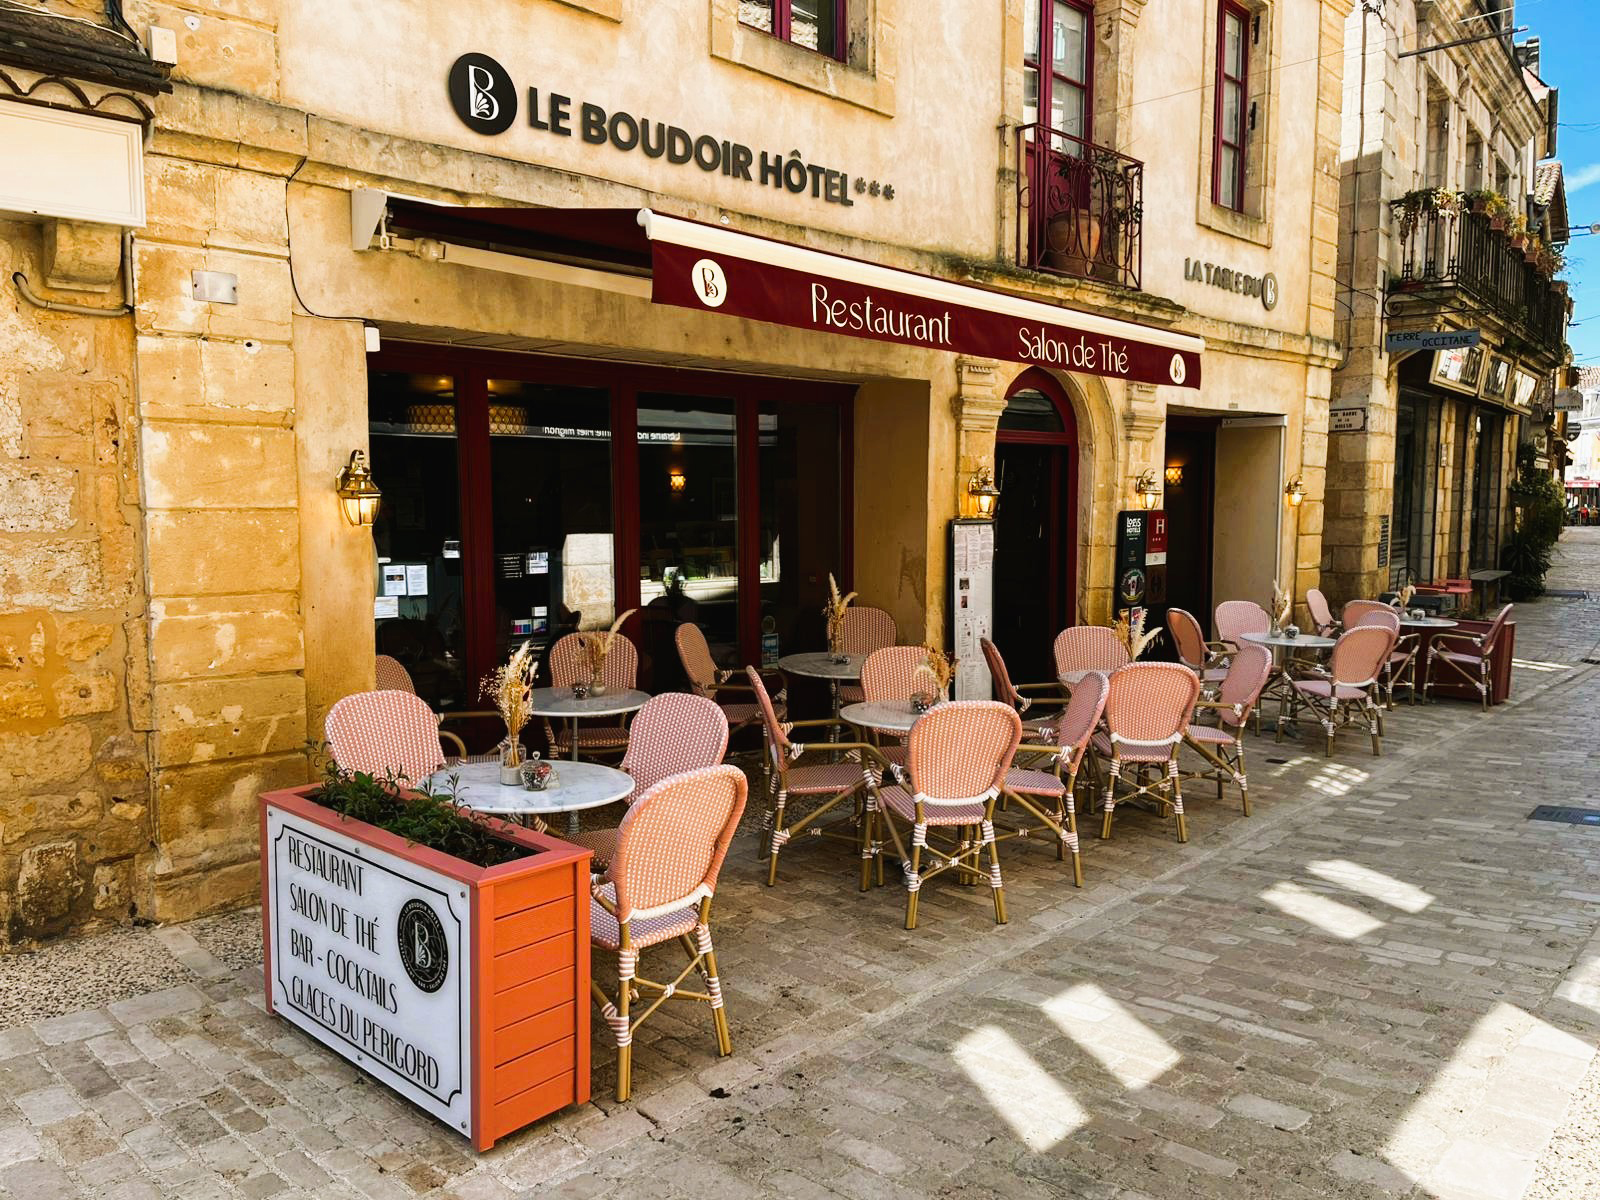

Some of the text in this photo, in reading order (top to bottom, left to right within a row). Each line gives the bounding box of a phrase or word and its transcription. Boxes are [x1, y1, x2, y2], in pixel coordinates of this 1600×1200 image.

[529, 86, 855, 207] LE BOUDOIR HÔTEL
[1184, 257, 1203, 282] LA
[1204, 262, 1243, 294] TABLE
[1243, 274, 1262, 298] DU
[811, 282, 952, 347] Restaurant
[1388, 332, 1473, 347] TERRE OCCITANE
[1018, 327, 1130, 374] Salon de Thé
[1155, 518, 1166, 534] H
[288, 836, 365, 897] RESTAURANT
[290, 882, 381, 955] SALON DE THÉ
[291, 929, 315, 967] BAR
[327, 949, 398, 1015] COCKTAILS
[292, 975, 440, 1090] GLACES DU PERIGORD
